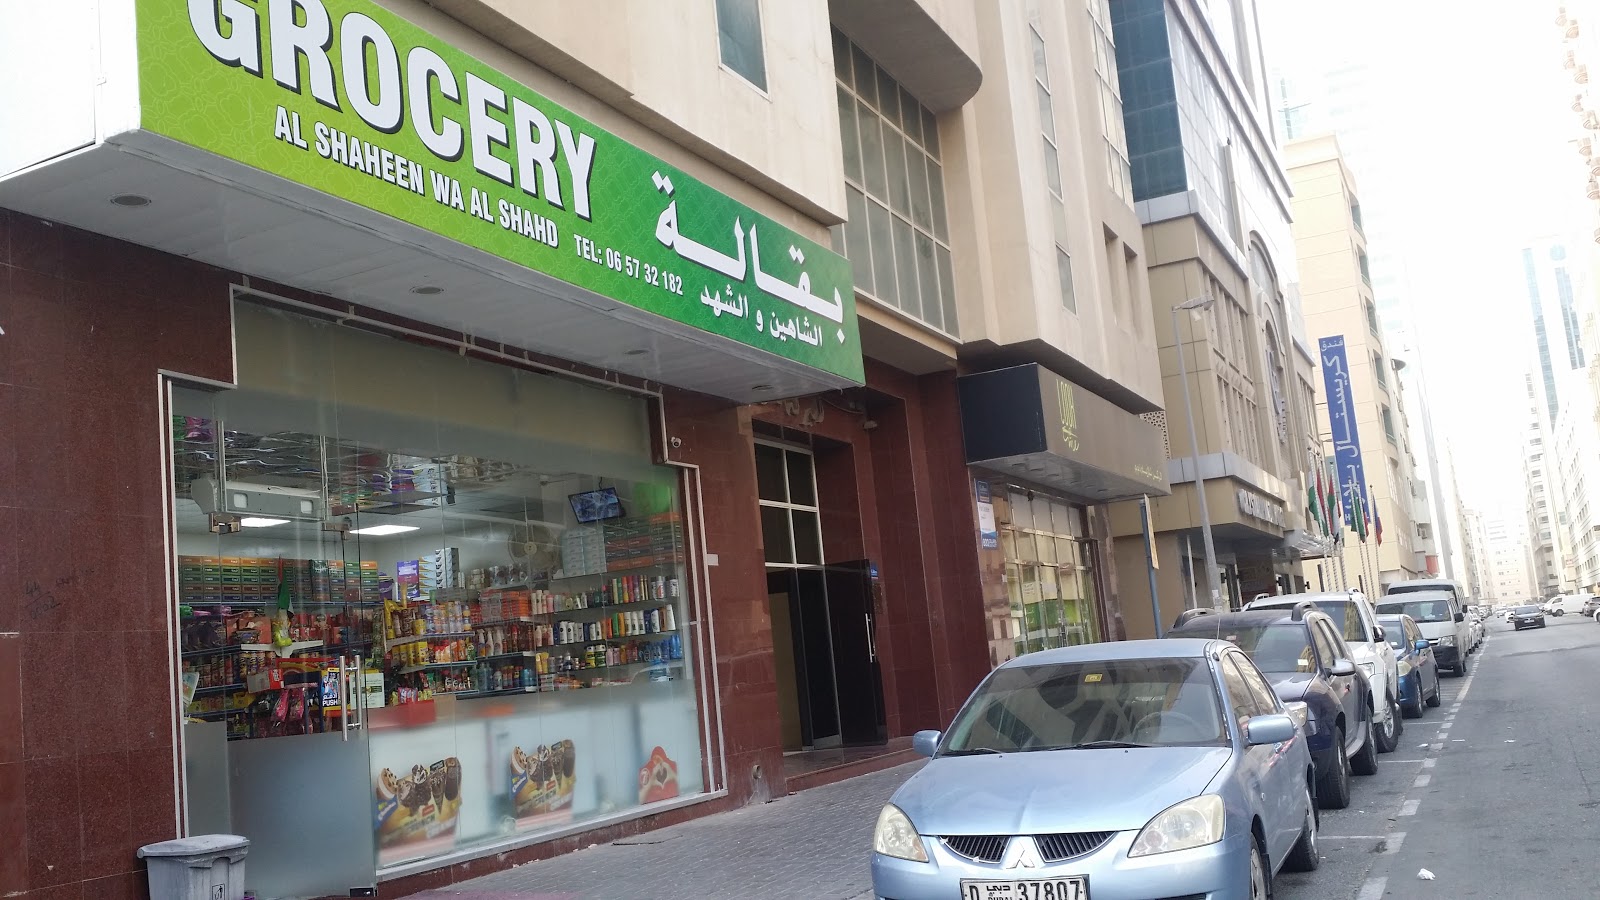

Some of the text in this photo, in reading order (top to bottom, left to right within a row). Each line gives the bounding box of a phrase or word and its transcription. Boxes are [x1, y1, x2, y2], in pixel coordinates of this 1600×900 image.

[187, 0, 597, 221] GROCERY
[274, 105, 559, 249] AL SHAHEEN WA AL SHAHD
[573, 233, 684, 296] TEL: 06 57 32 182
[651, 170, 845, 344] بقالة
[700, 283, 823, 347] الشاهين و الشهد
[1321, 338, 1345, 352] فندق
[1323, 354, 1359, 458] كريستال
[322, 699, 338, 707] PUSH
[968, 885, 980, 900] D
[1017, 880, 1080, 900] 37807
